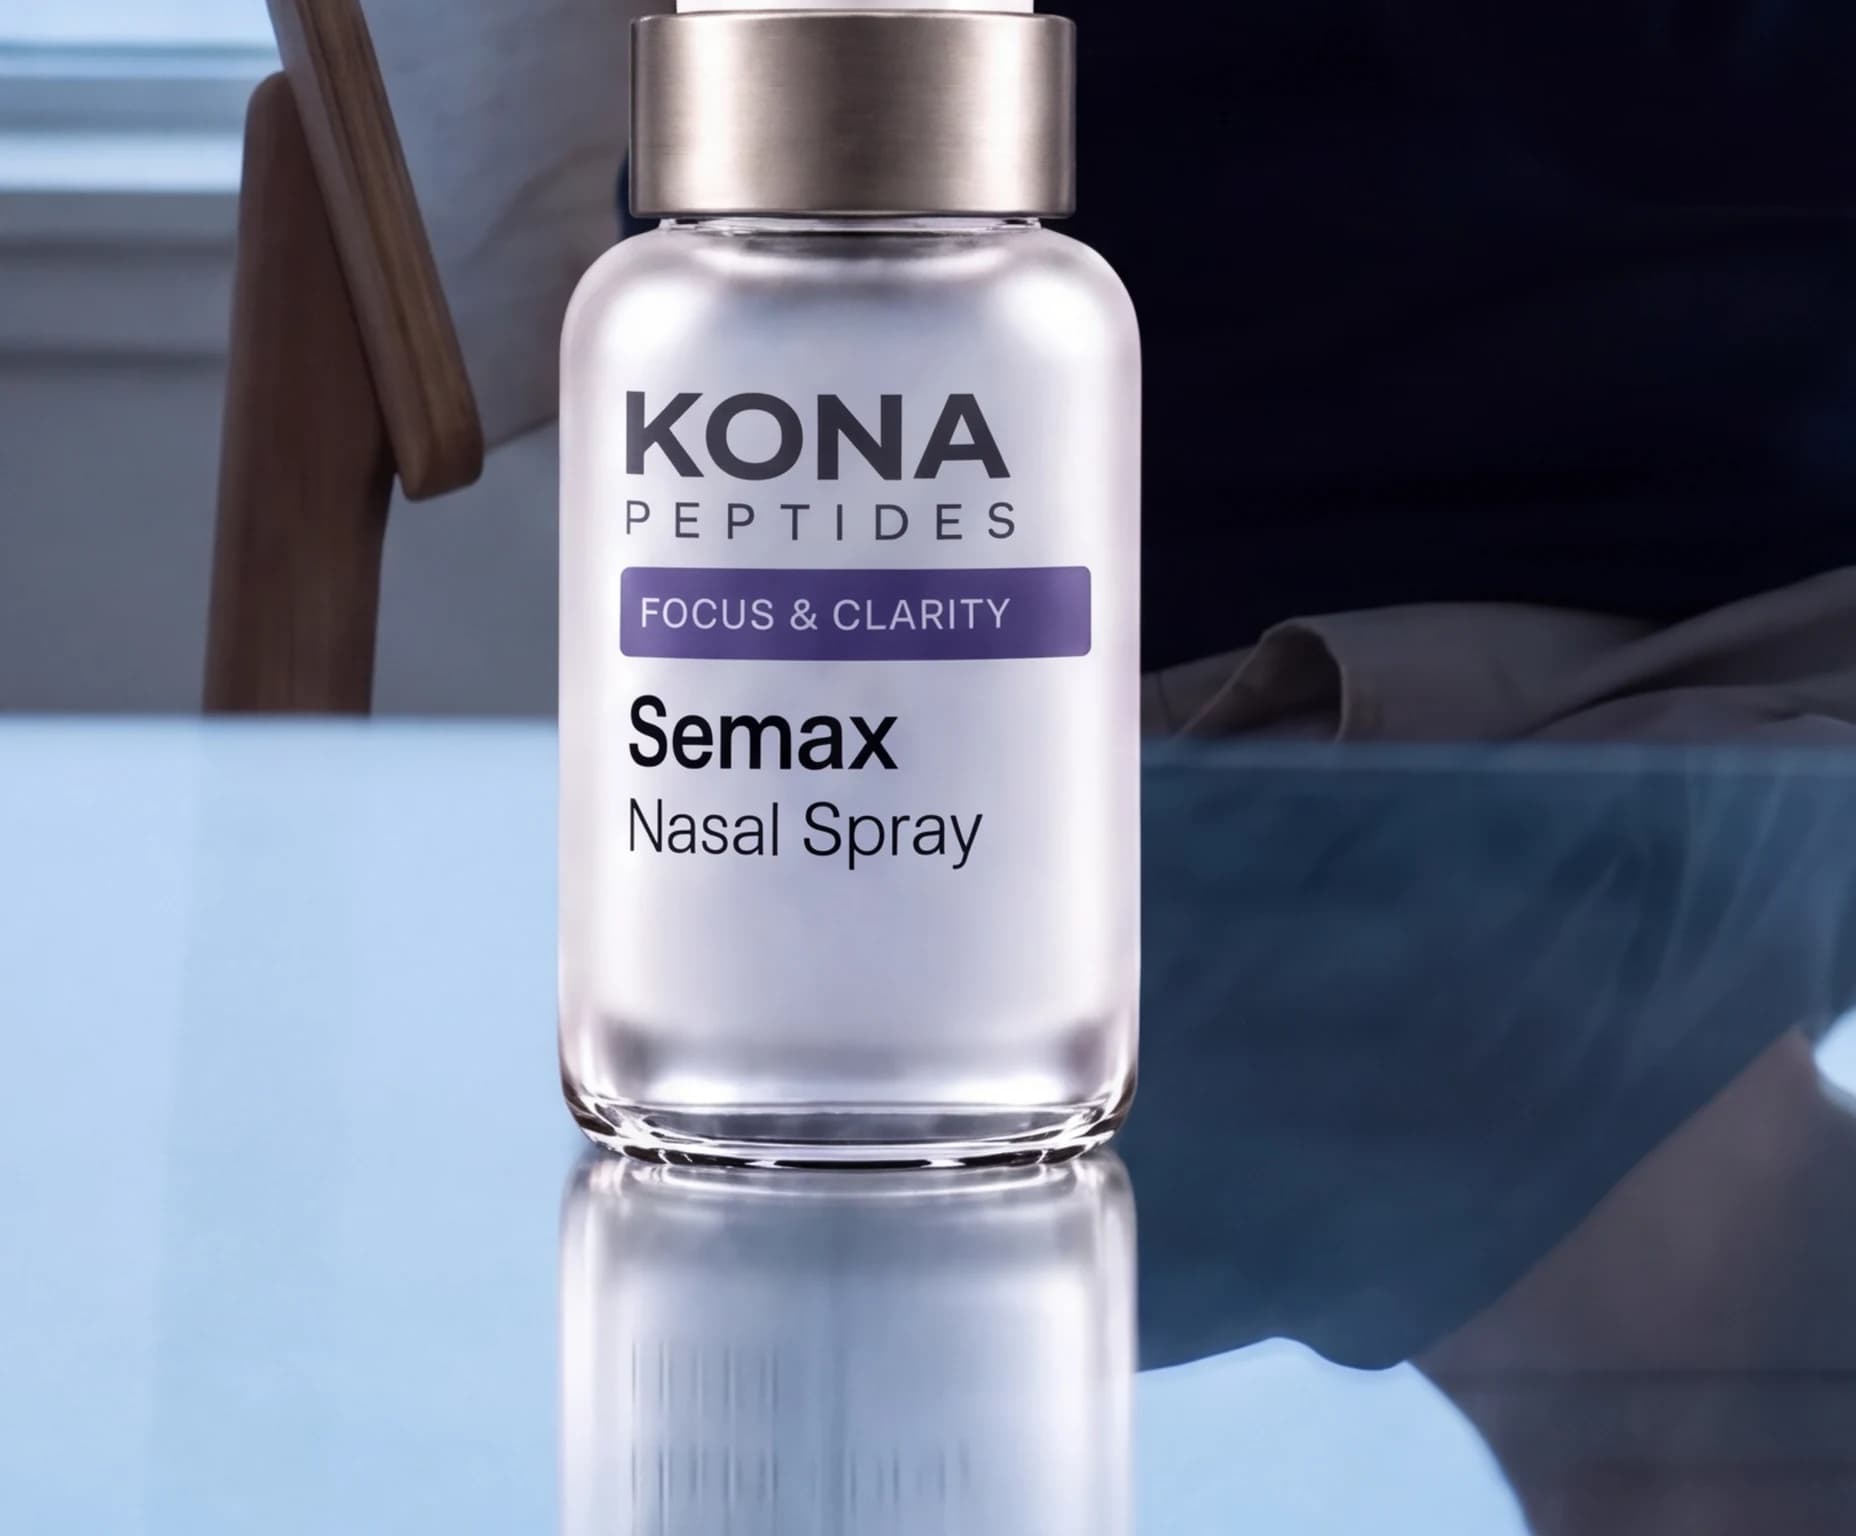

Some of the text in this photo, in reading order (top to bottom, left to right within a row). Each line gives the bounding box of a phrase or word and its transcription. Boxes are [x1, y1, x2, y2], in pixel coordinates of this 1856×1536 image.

[626, 390, 1011, 481] KONA
[625, 499, 1016, 541] PEPTIDES
[640, 596, 1011, 631] FOCUS & CLARITY
[628, 694, 899, 771] Semax
[629, 797, 984, 871] Nasal Spray
